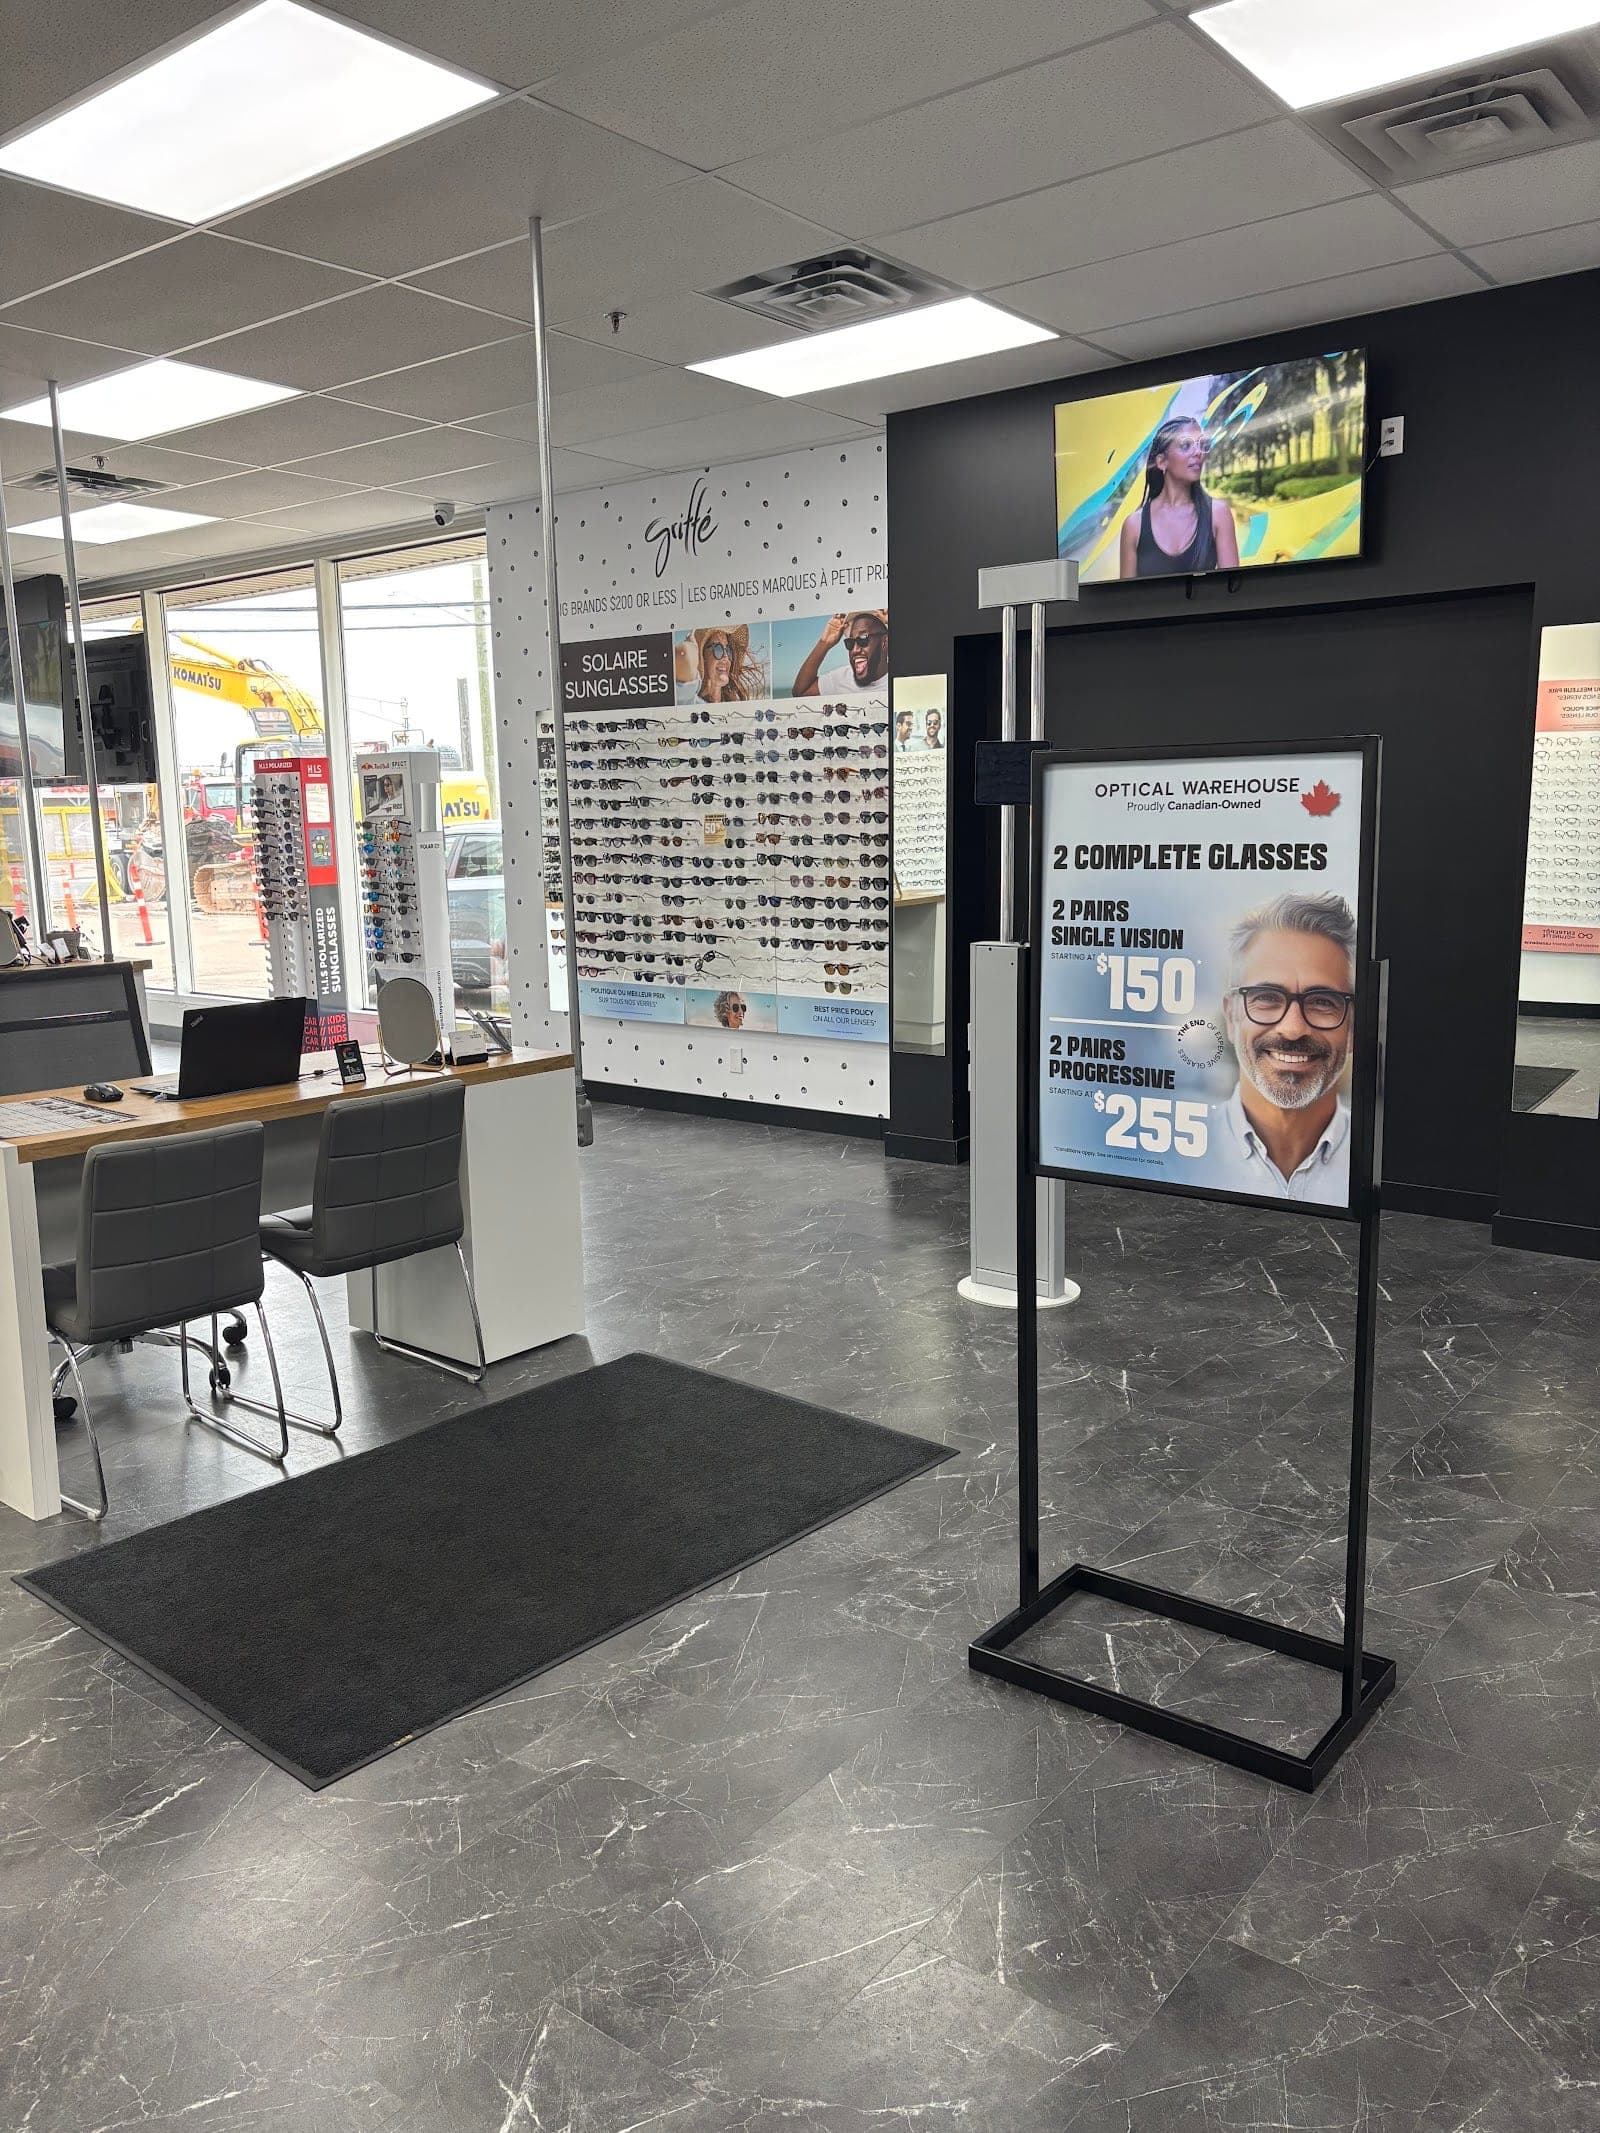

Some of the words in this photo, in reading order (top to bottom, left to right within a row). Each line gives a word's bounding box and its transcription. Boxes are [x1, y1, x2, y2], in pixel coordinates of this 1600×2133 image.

[560, 602, 568, 616] IG
[571, 597, 608, 616] BRANDS
[610, 594, 633, 612] $200
[636, 593, 650, 608] OR
[652, 589, 678, 606] LESS
[687, 586, 707, 604] LES
[709, 580, 760, 600] GRANDES
[762, 573, 818, 594] MARQUES
[820, 568, 828, 587] À
[831, 566, 863, 586] PETIT
[582, 649, 648, 674] SOLAIRE
[173, 666, 222, 690] KOMATSU
[565, 674, 669, 700] SUNGLASSES
[1095, 781, 1174, 798] OPTICAL
[1182, 777, 1300, 795] WAREHOUSE
[1127, 801, 1165, 812] Proudly
[1168, 798, 1261, 810] Canadian-Owned
[1053, 844, 1068, 870] 2
[1075, 844, 1202, 870] COMPLETE
[1208, 843, 1328, 870] GLASSES
[1052, 900, 1065, 921] 2
[1071, 900, 1129, 922] PAIRS
[316, 908, 328, 968] POLARIZED
[1051, 926, 1115, 948] SINGLE
[1120, 928, 1184, 949] VISION
[326, 906, 341, 992] SUNGLASSES
[1051, 952, 1085, 961] STARTING
[1086, 953, 1096, 961] AT
[320, 970, 330, 995] H.I.S
[590, 987, 617, 995] POLITIQUE
[627, 990, 652, 998] MEILLEUR
[327, 1014, 346, 1024] KIDS
[850, 1008, 874, 1016] POLICY
[328, 1024, 347, 1034] KIDS
[1177, 1023, 1189, 1036] THE
[1190, 1019, 1205, 1027] END
[1206, 1022, 1217, 1032] OF
[328, 1034, 348, 1044] KIDS
[1049, 1034, 1061, 1056] 2
[1067, 1035, 1125, 1061] PAIRS
[1178, 1048, 1206, 1069] GLASSES
[1207, 1032, 1224, 1068] EXPENSIVE
[1049, 1059, 1176, 1090] PROGRESSIVE
[1048, 1087, 1083, 1097] STARTING
[1084, 1090, 1094, 1098] AT
